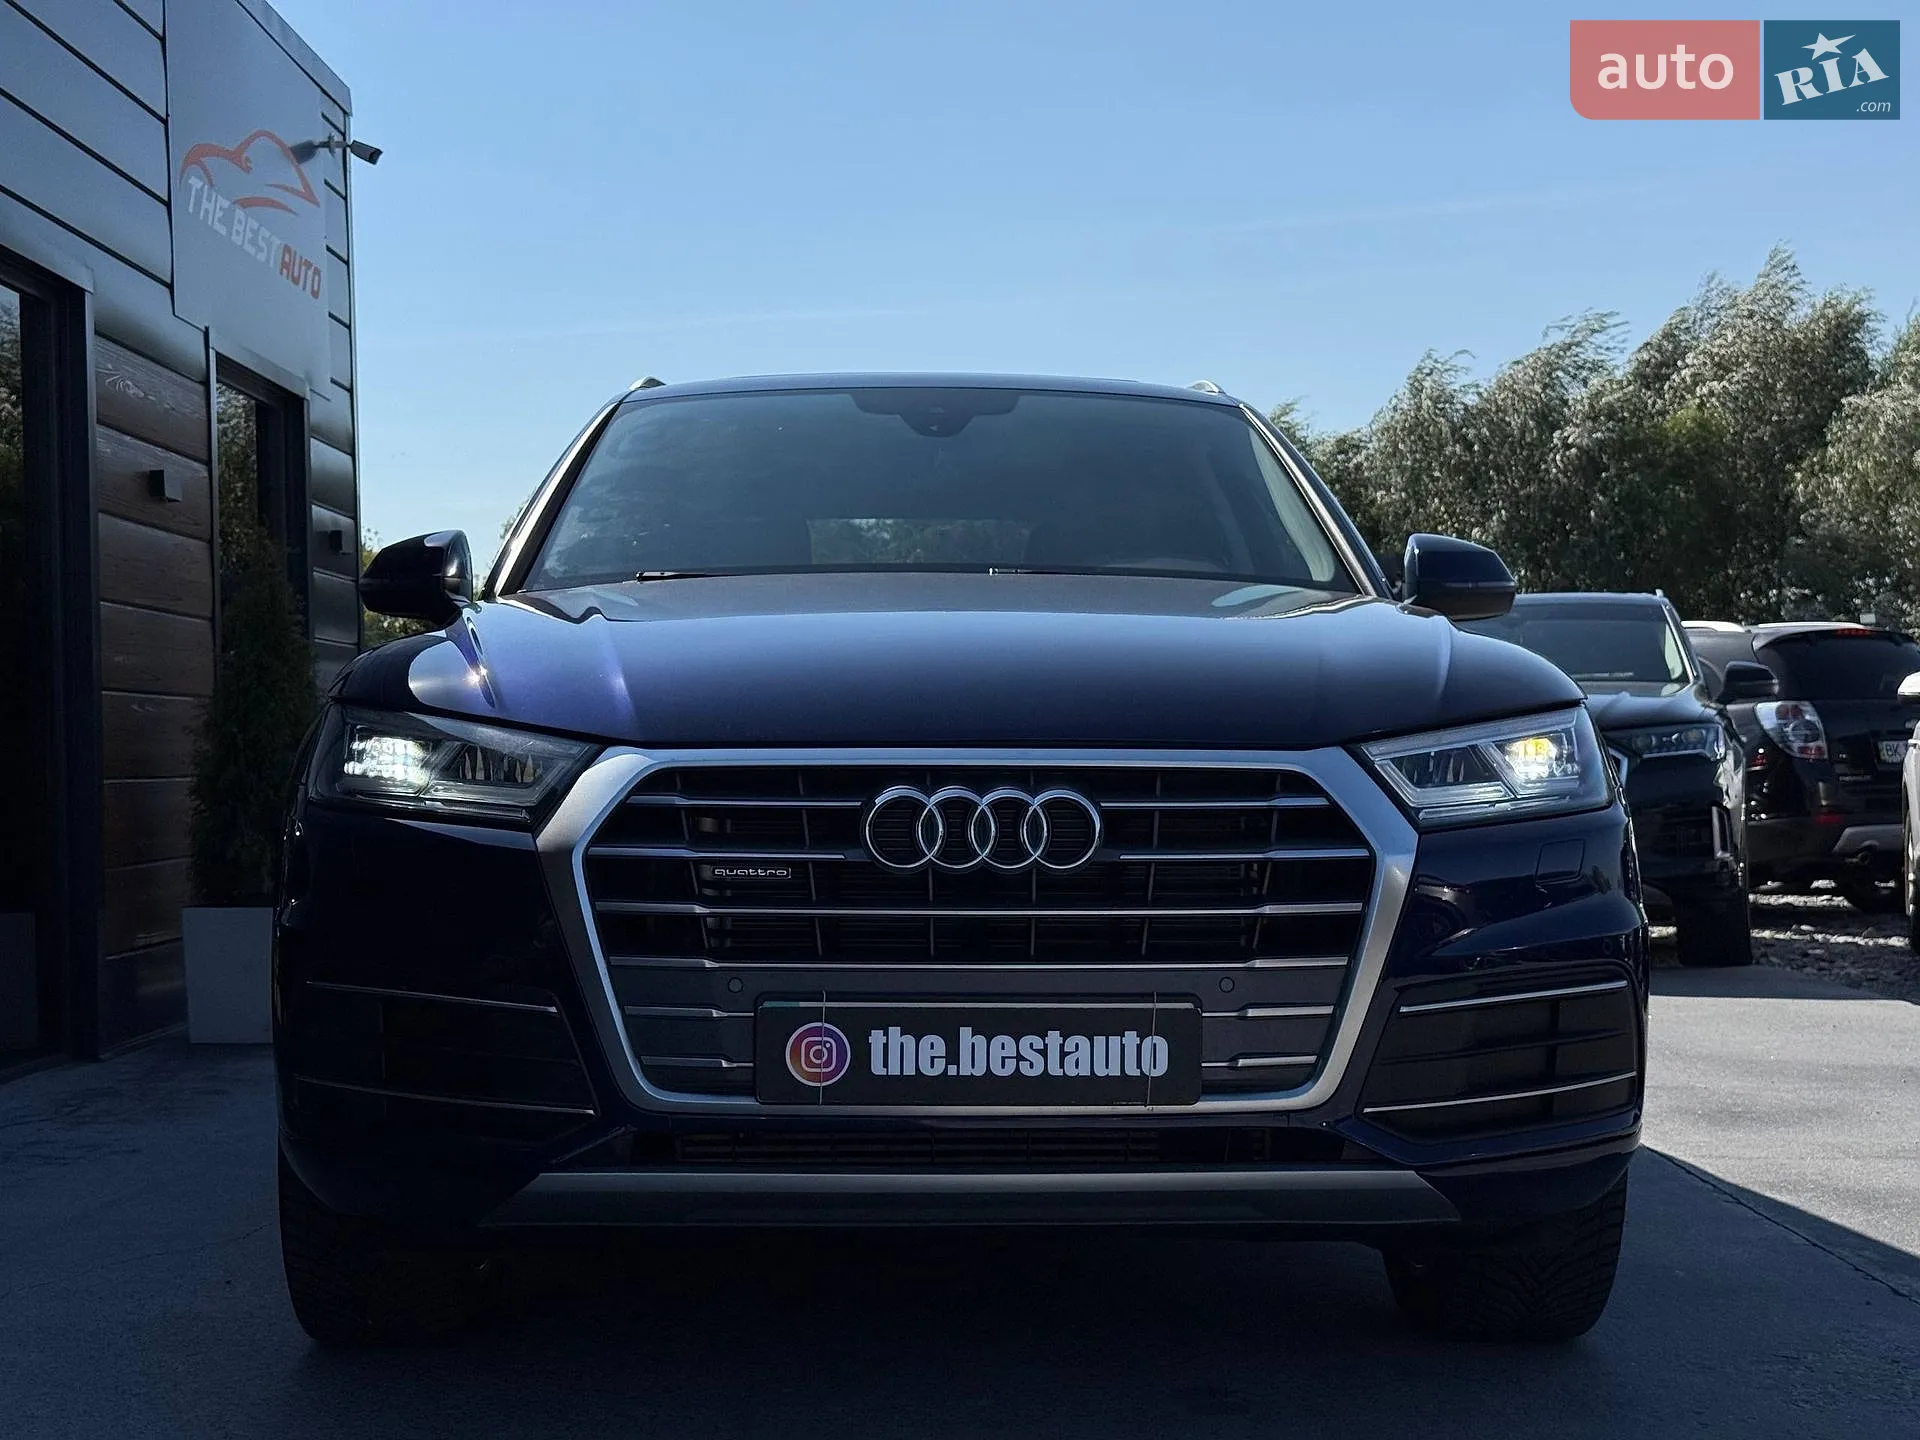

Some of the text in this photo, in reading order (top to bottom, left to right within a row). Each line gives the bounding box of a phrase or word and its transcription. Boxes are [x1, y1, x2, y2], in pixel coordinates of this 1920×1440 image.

[187, 176, 231, 236] THE
[714, 868, 787, 877] quattro
[868, 1026, 1169, 1077] the.bestauto
